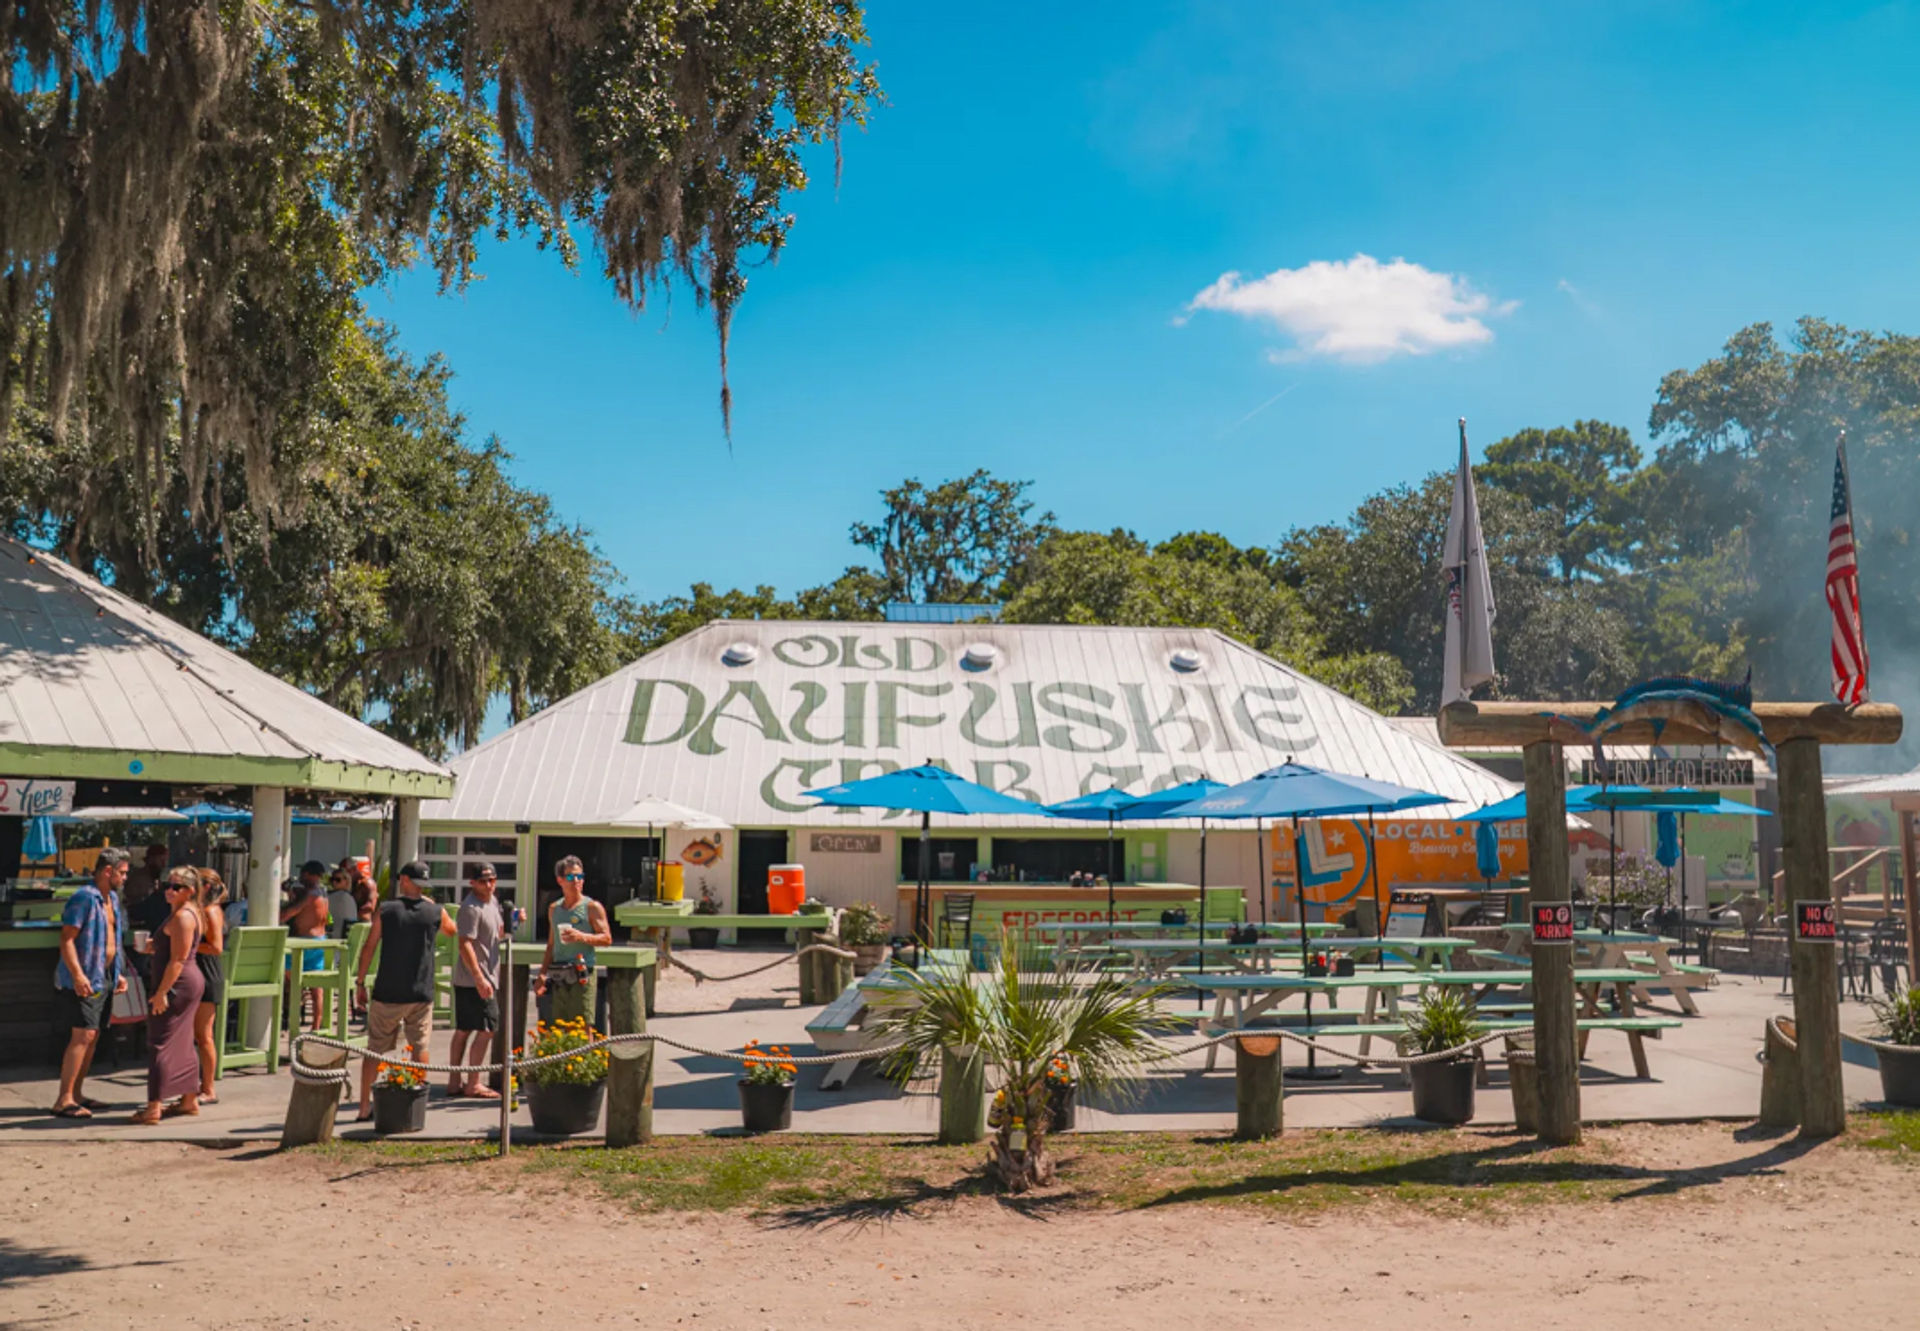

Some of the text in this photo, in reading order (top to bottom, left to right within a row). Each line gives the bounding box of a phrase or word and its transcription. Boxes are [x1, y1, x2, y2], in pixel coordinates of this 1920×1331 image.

[772, 634, 947, 672] OLD
[621, 678, 1319, 756] DAUFUSKIE
[1587, 759, 1748, 785] ISAND HEAD FERRY
[760, 757, 1041, 820] CRB
[1371, 823, 1451, 840] LOCAL
[1538, 908, 1553, 922] NO
[1806, 906, 1821, 921] NO
[1535, 923, 1573, 938] PARKIN
